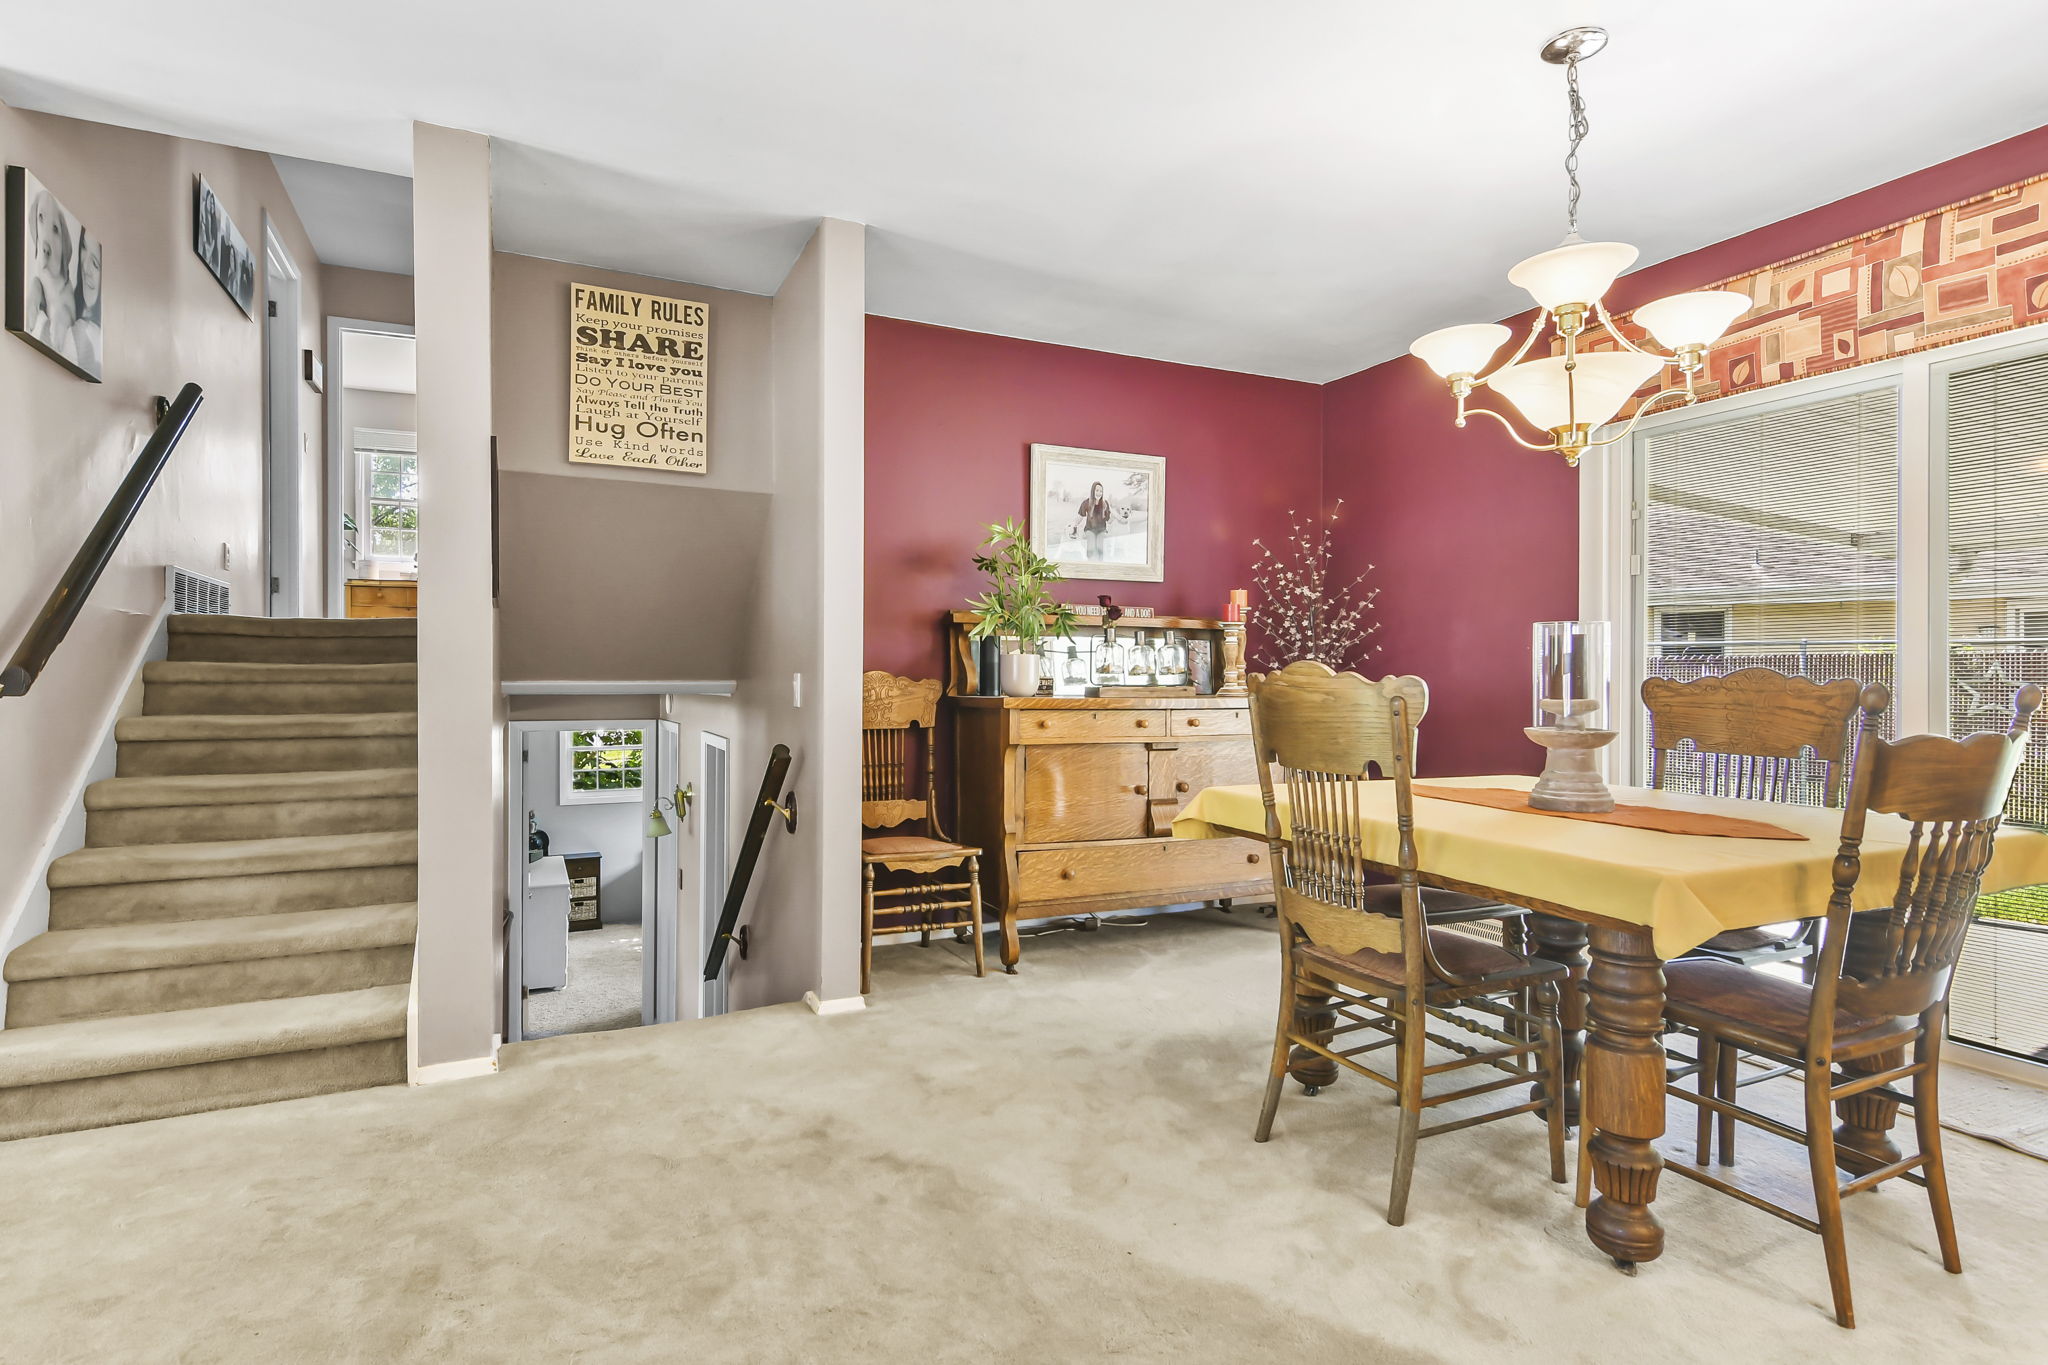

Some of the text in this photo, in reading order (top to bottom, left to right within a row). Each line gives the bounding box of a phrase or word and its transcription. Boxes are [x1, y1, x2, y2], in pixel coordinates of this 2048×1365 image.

[575, 288, 704, 326] FAMILY RULES
[576, 314, 704, 339] Keep your promises
[576, 326, 704, 361] SHARE
[576, 352, 703, 377] Say I love you
[644, 354, 668, 362] before
[576, 364, 612, 375] Listen
[632, 372, 659, 381] your
[662, 376, 703, 386] parents
[576, 386, 594, 395] Say
[598, 389, 627, 398] Please
[630, 393, 648, 401] and
[652, 396, 682, 404] Thank
[576, 395, 702, 416] Always Tell the Truth
[576, 404, 620, 418] Laugh
[644, 412, 702, 426] Yourself
[575, 414, 703, 443] Hug Often
[575, 436, 704, 456] Use Kind Words
[575, 448, 702, 468] Love Each Other
[1075, 605, 1085, 615] YOU
[1085, 605, 1101, 615] NEED
[1124, 607, 1135, 617] AND
[1135, 608, 1140, 618] A
[1140, 608, 1152, 618] DOG
